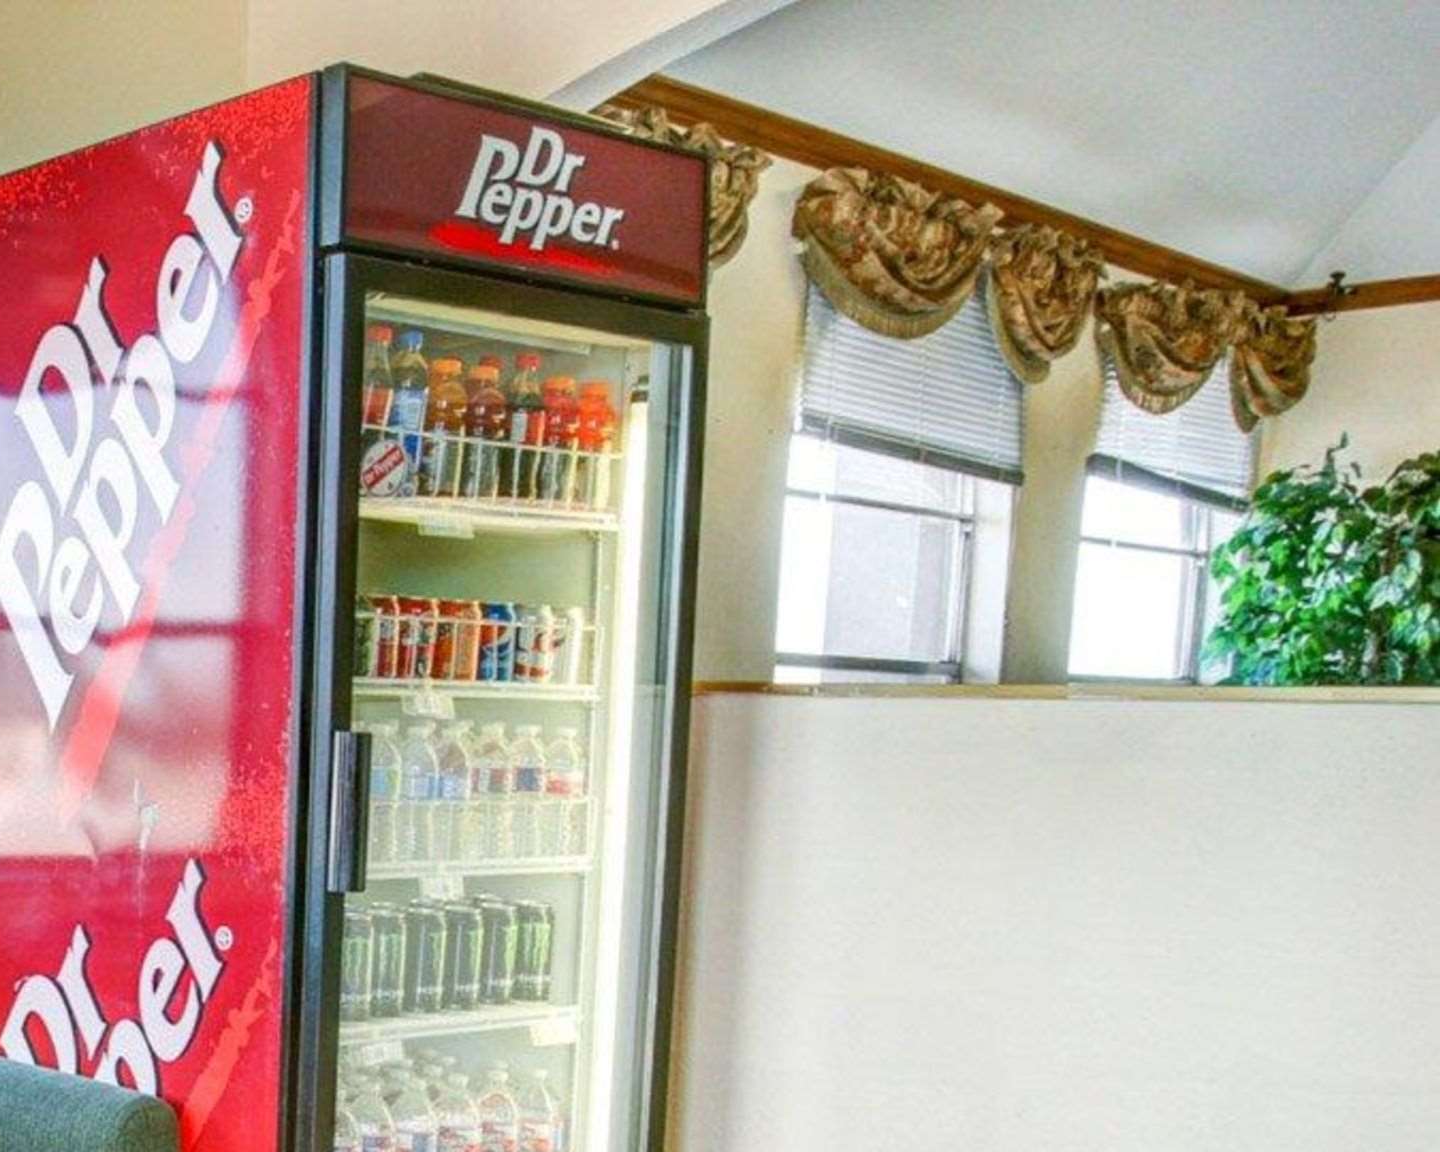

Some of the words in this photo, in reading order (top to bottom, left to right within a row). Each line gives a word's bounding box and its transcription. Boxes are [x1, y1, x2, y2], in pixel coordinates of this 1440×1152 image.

[455, 133, 625, 251] Pepper
[515, 125, 585, 193] Dr
[13, 252, 127, 518] Dr
